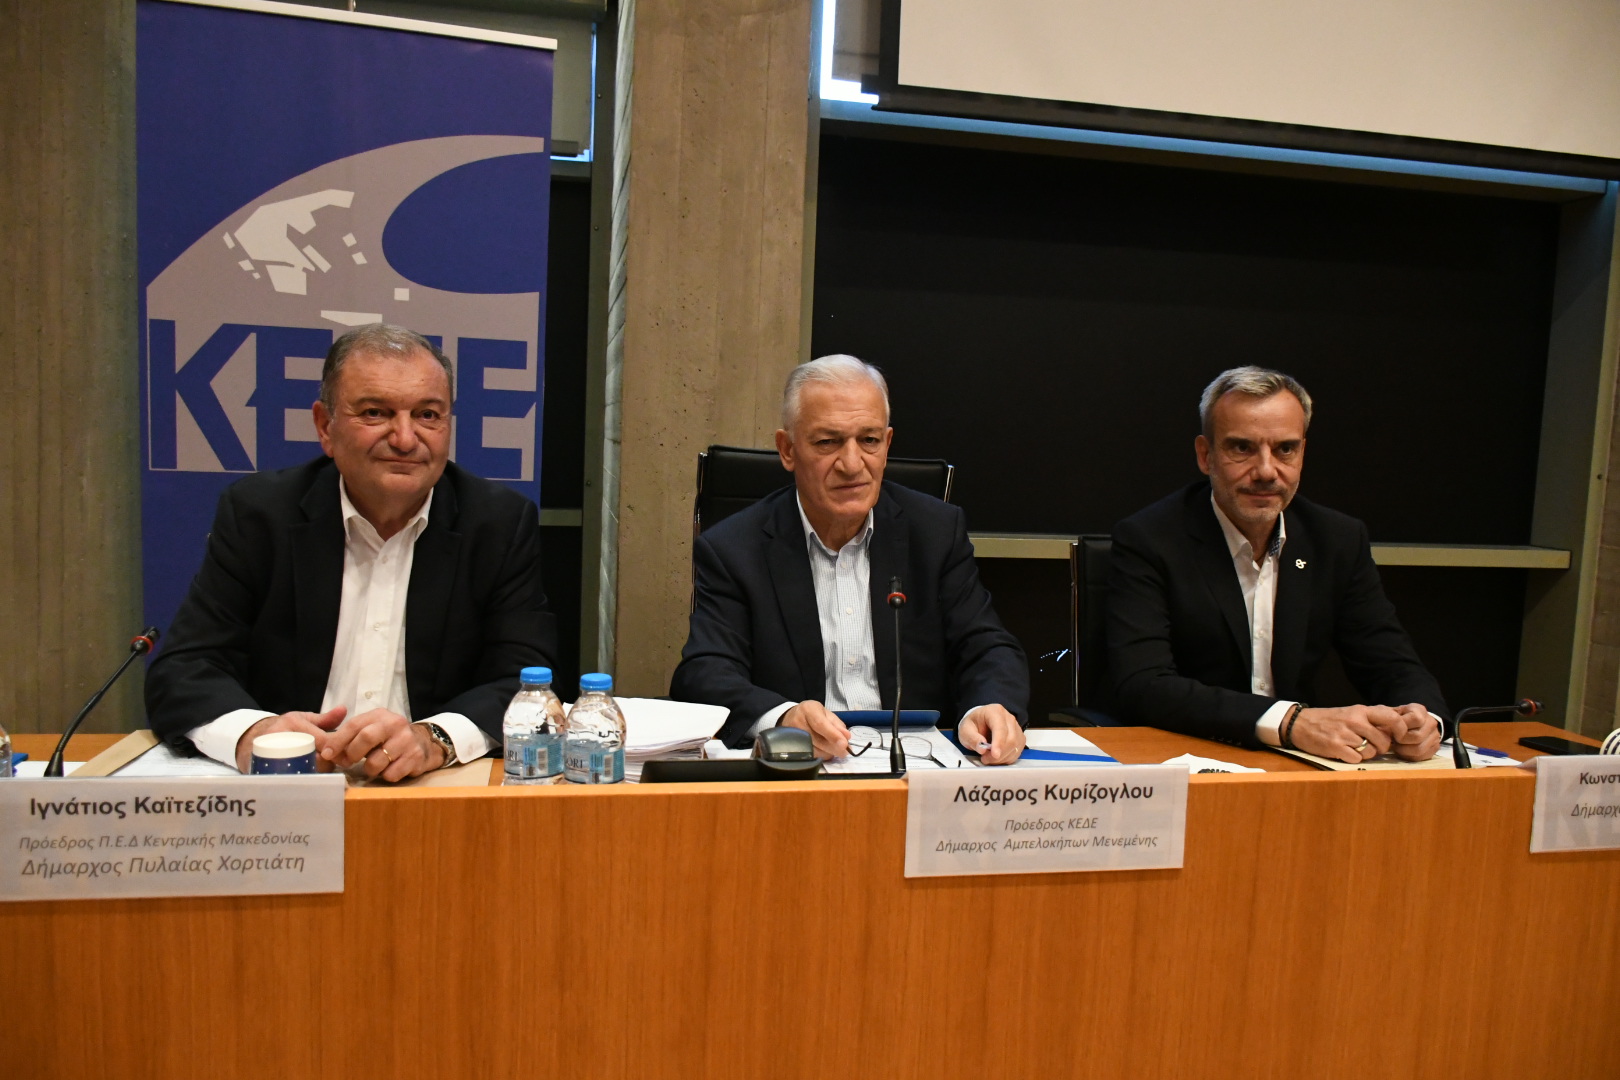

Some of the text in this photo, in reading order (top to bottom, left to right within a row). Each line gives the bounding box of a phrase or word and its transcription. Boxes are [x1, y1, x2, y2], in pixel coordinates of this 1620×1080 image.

[953, 783, 1154, 806] Λάζαρος Κυρίζογλου
[30, 796, 256, 820] Ιγνάτιος Καϊτεζίδης
[1004, 818, 1099, 832] Πρόεδρος ΚΕΔΕ
[19, 832, 310, 851] Πρόεδρος Π.Ε.Δ Κεντρικής Μακεδονίας
[936, 835, 1158, 854] Δήμαρχος Αμπελοκήπων Μενεμένης
[21, 854, 305, 877] Δήμαρχος Πυλαίας Χορτιάτη
